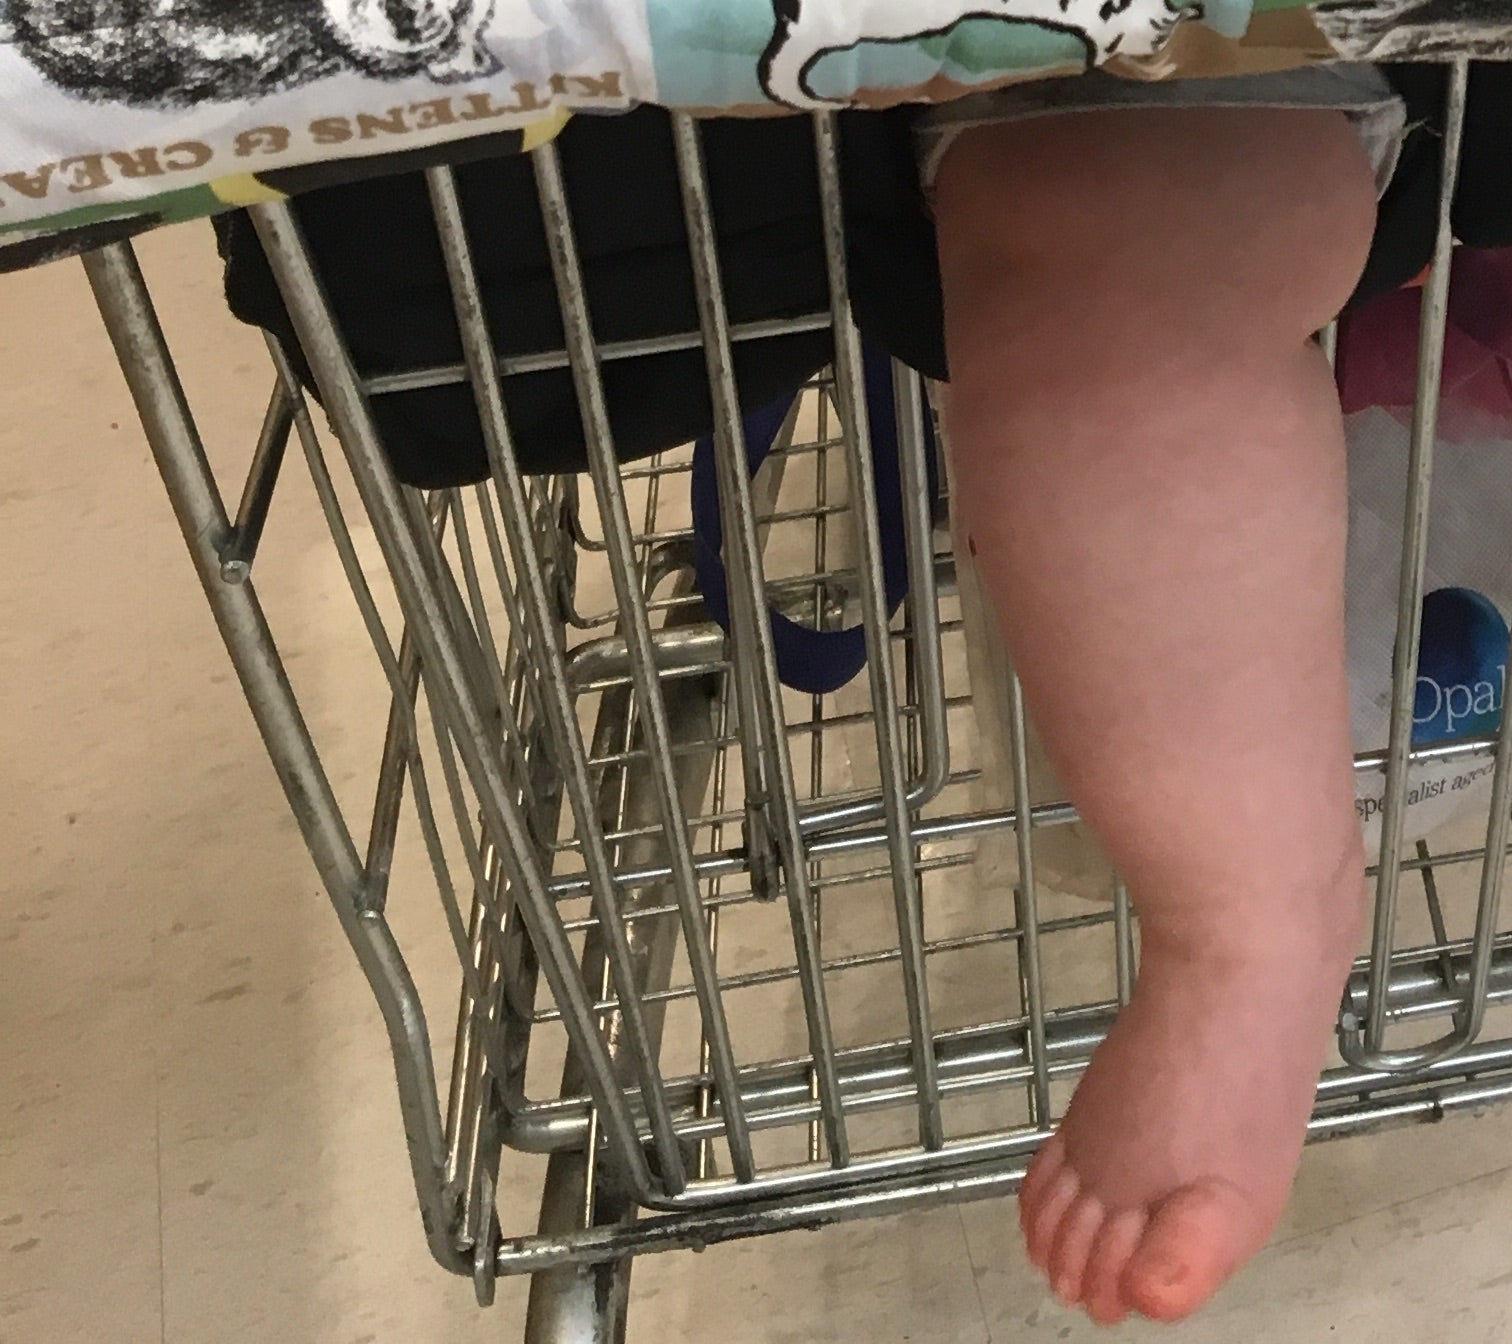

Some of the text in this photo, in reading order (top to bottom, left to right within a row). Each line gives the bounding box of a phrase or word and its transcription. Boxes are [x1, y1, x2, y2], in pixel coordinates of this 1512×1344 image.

[0, 70, 625, 200] KITTENS & CREA
